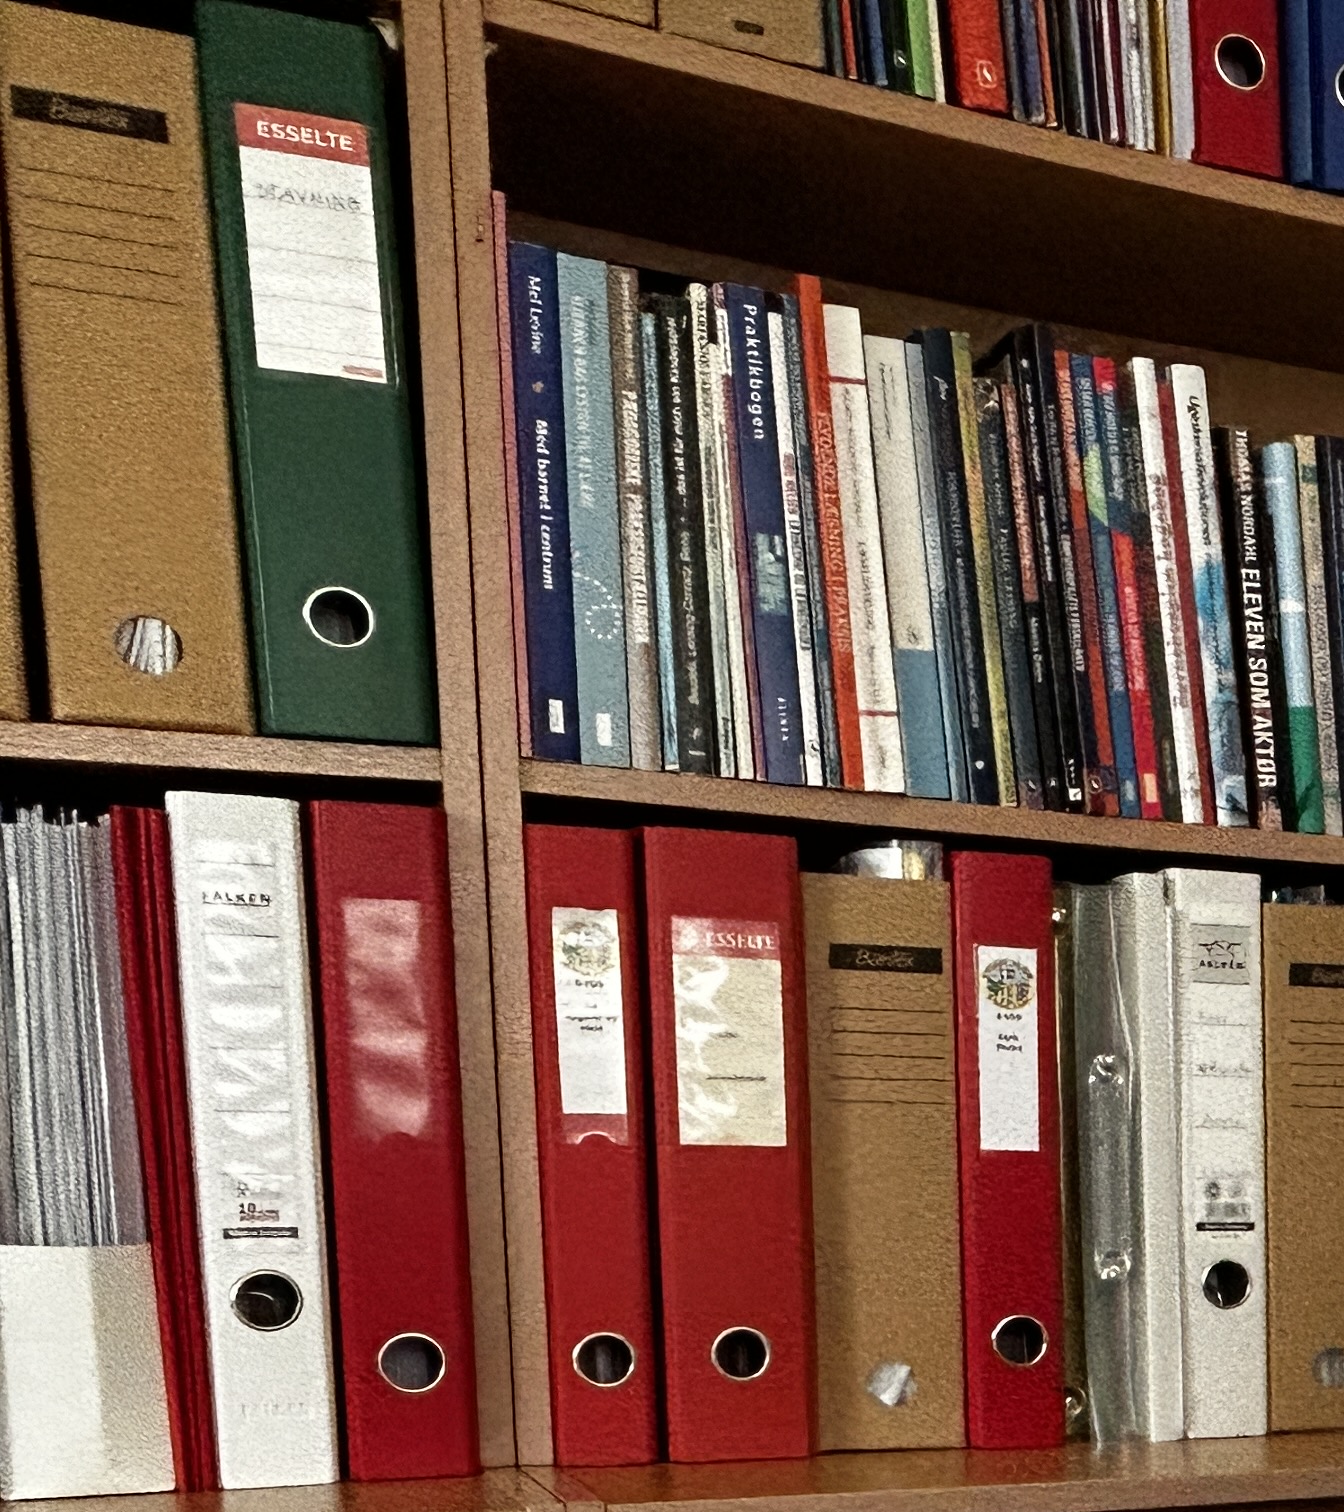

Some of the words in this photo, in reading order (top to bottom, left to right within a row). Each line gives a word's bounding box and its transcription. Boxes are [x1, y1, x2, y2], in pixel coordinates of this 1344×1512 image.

[256, 120, 355, 152] ESSELTE
[739, 303, 768, 440] Praktikbogen
[534, 419, 550, 452] Med
[536, 459, 553, 508] barnet
[540, 524, 558, 590] centrum
[1239, 494, 1260, 564] NORDAHL
[1240, 567, 1266, 650] ELEVEN
[1247, 656, 1271, 708] SOM
[1251, 714, 1277, 788] AKTØR
